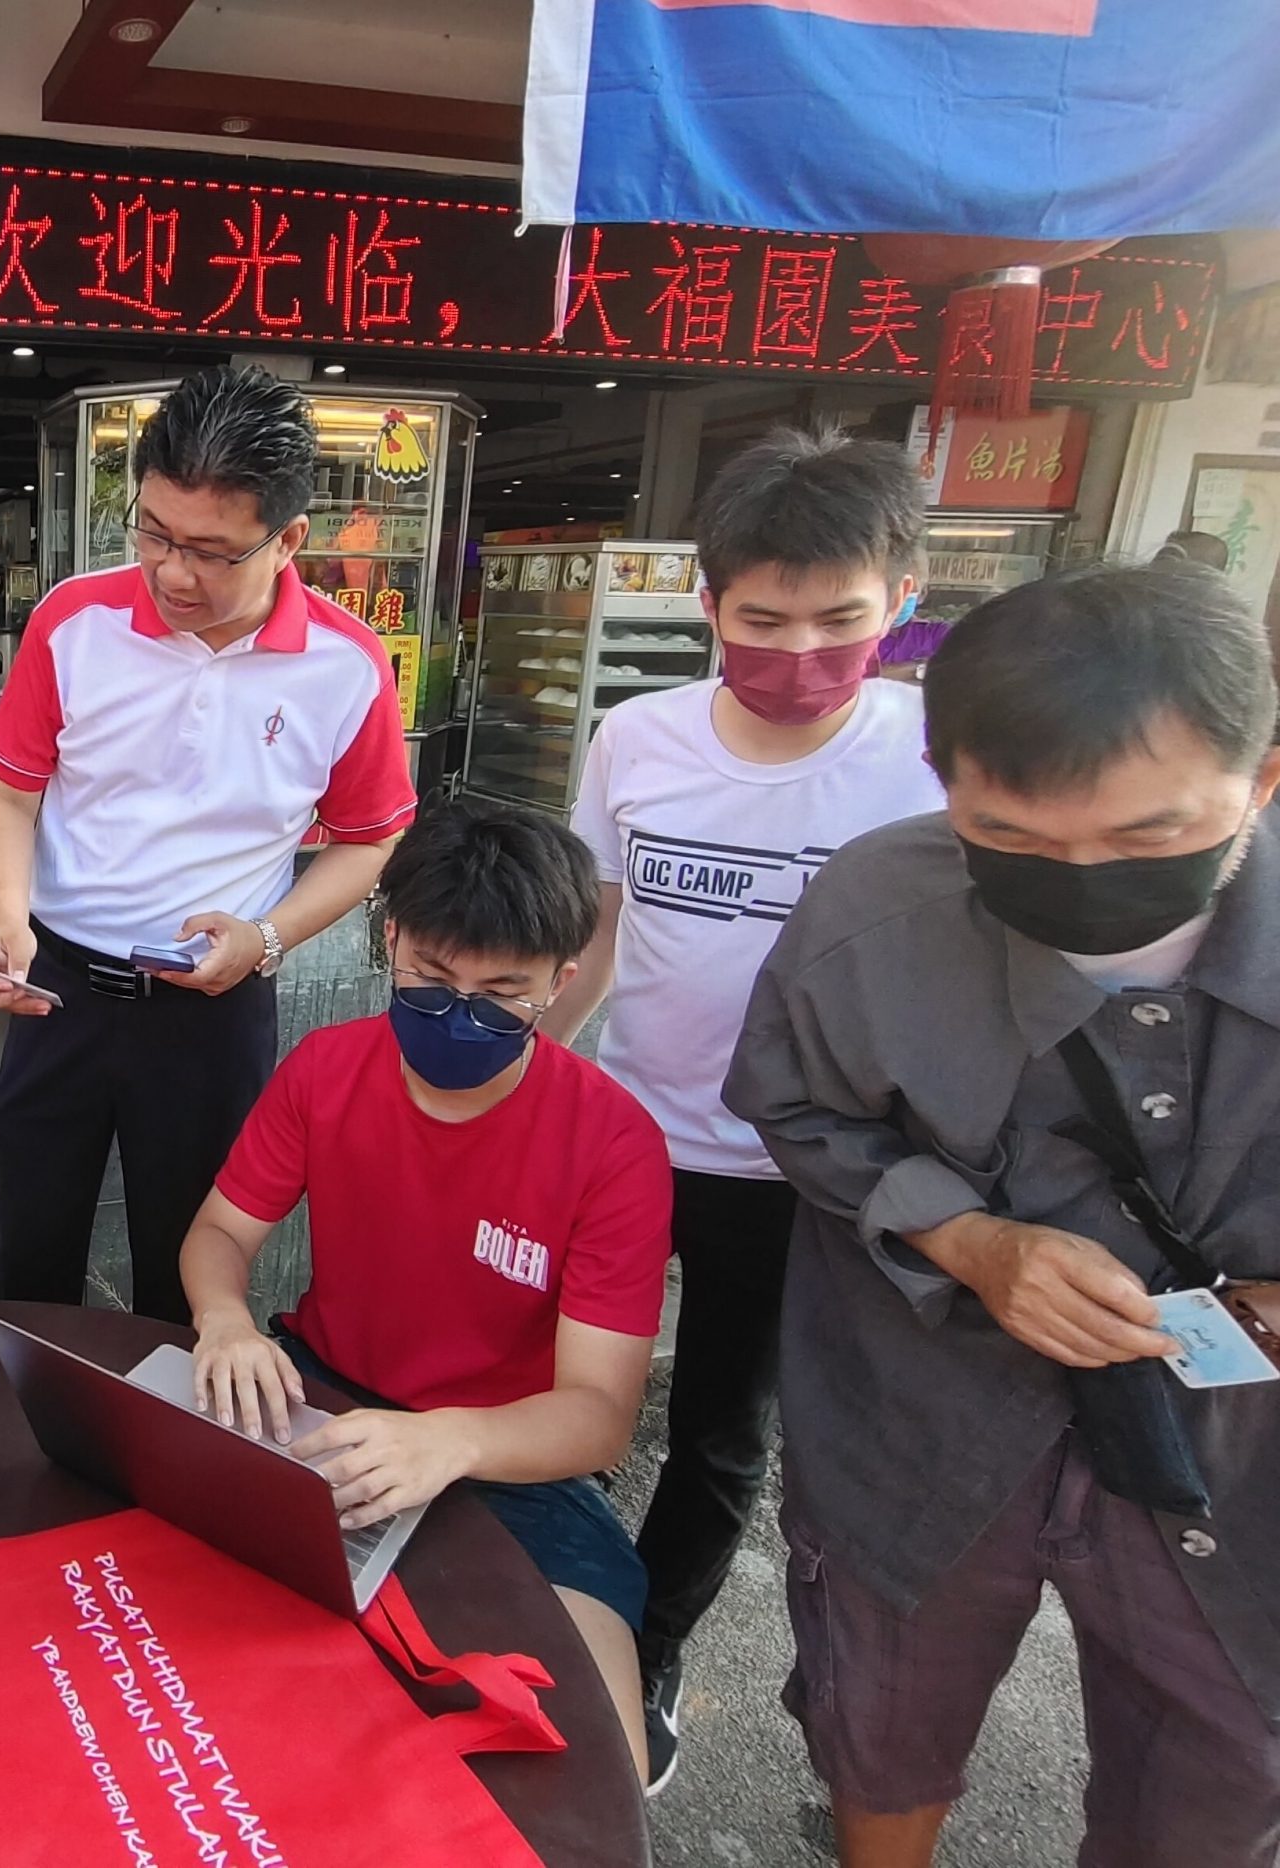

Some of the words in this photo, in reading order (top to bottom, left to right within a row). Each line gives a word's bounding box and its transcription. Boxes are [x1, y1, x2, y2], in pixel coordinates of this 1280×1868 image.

[964, 431, 1065, 483] 魚片湯
[312, 585, 405, 634] 園雞
[677, 863, 754, 899] CAMP
[473, 1219, 550, 1292] BOLEH
[60, 1560, 130, 1670] RAKYAT
[112, 1668, 162, 1733] DUN
[93, 1551, 154, 1635] PUSAT
[136, 1636, 230, 1772] KHIDMAT
[213, 1774, 290, 1868] WAKI
[32, 1635, 60, 1666] YB
[48, 1665, 106, 1760] ANDREW
[92, 1761, 136, 1825] CHEN
[121, 1828, 158, 1868] KA
